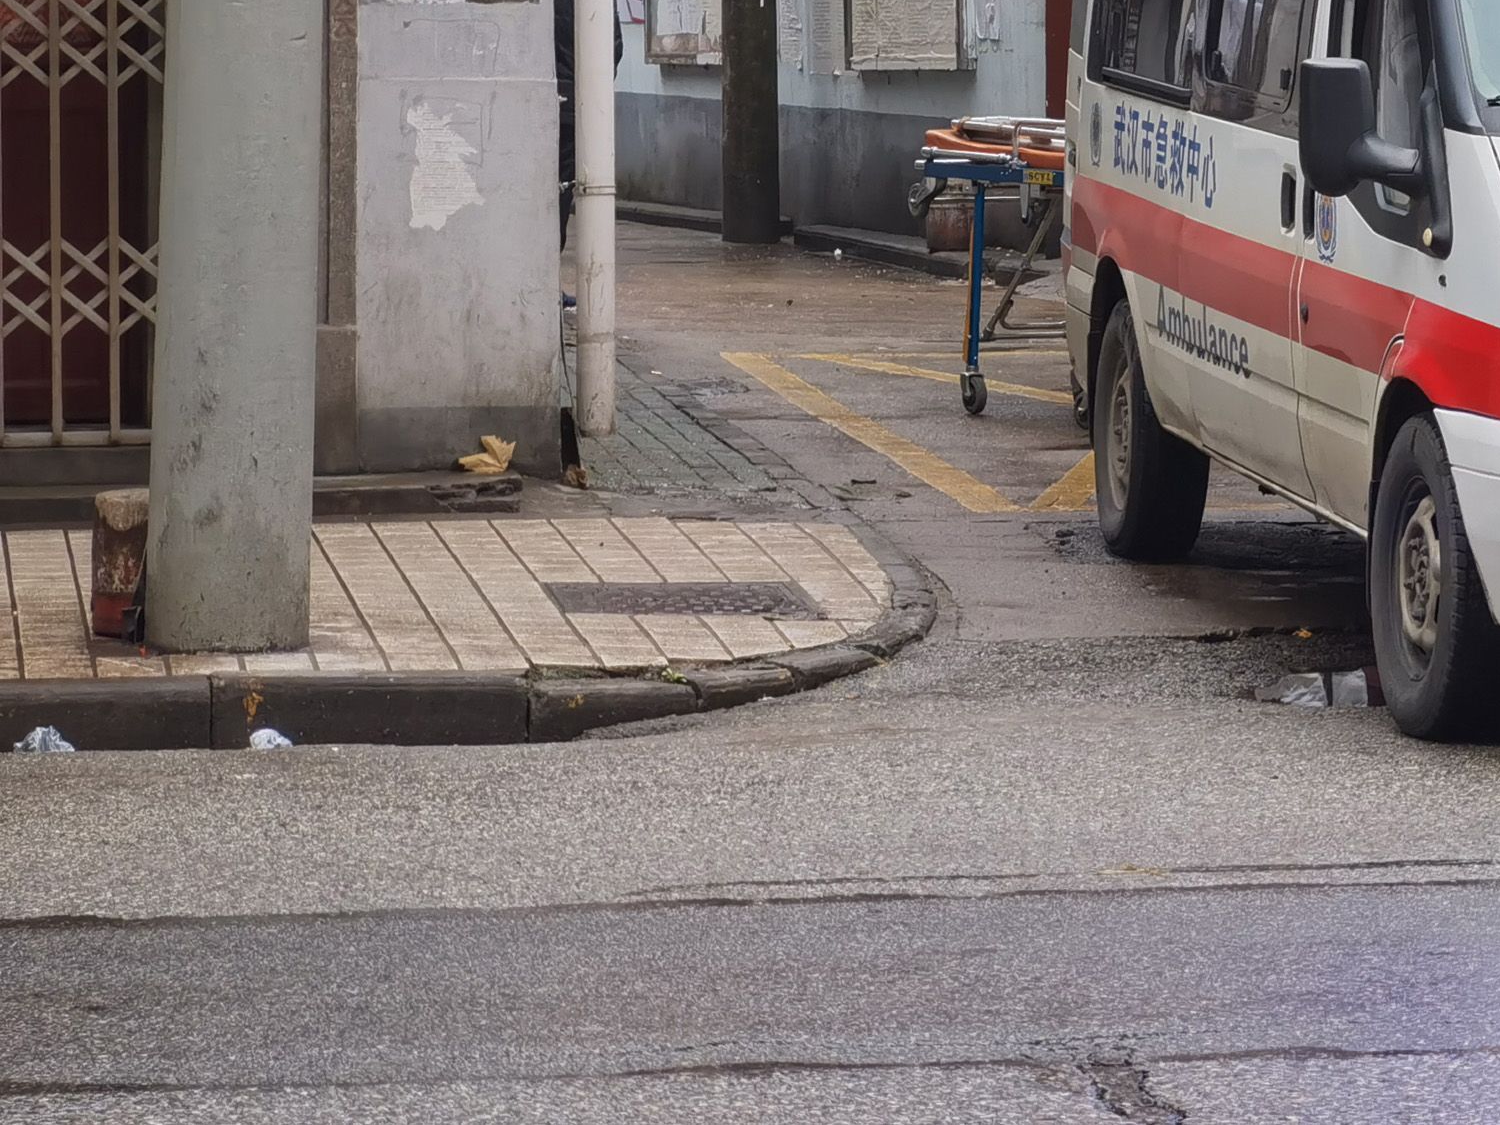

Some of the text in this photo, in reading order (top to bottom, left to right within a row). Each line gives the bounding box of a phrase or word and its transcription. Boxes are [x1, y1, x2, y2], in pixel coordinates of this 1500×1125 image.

[1113, 100, 1217, 209] 武汉市急救中心
[1157, 285, 1251, 379] Ambulance
